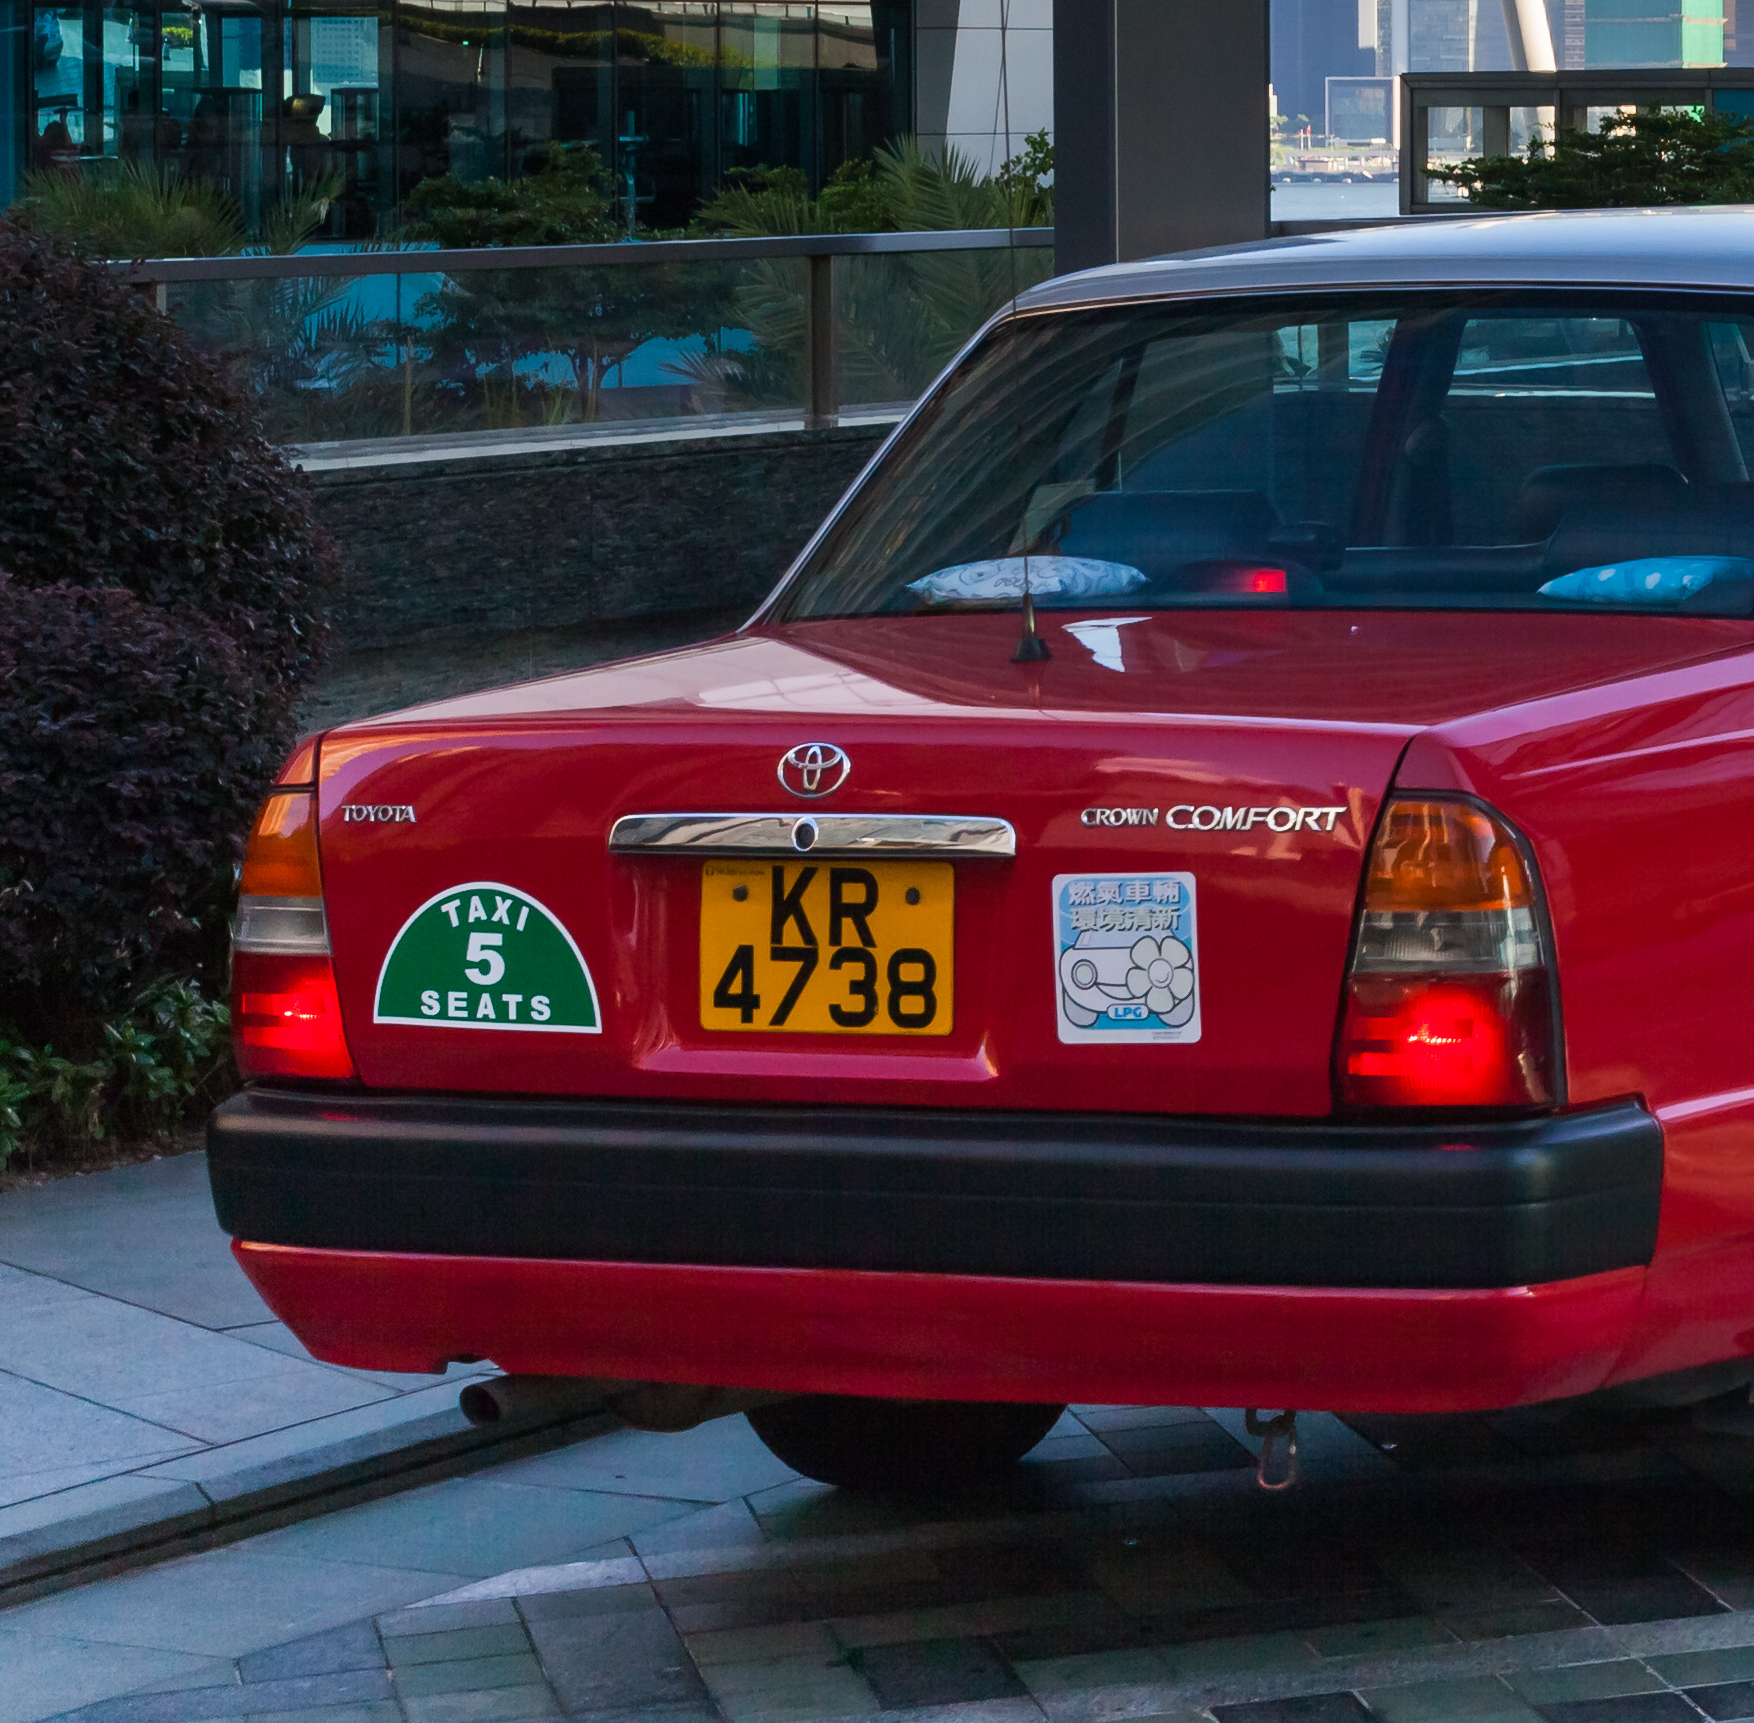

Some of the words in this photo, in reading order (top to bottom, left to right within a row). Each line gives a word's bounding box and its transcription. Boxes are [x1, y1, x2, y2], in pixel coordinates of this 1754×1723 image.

[342, 804, 417, 824] TOYOTA
[1080, 807, 1159, 827] CROWN
[1165, 804, 1348, 832] COMFORT
[770, 865, 879, 948] KR
[1068, 880, 1181, 906] 燃氣車輛
[440, 895, 530, 932] TAXI
[1070, 907, 1181, 933] 環境清新
[464, 931, 506, 986] 5
[713, 944, 938, 1029] 4738
[420, 989, 552, 1021] SEATS
[1114, 1006, 1143, 1018] LPG
